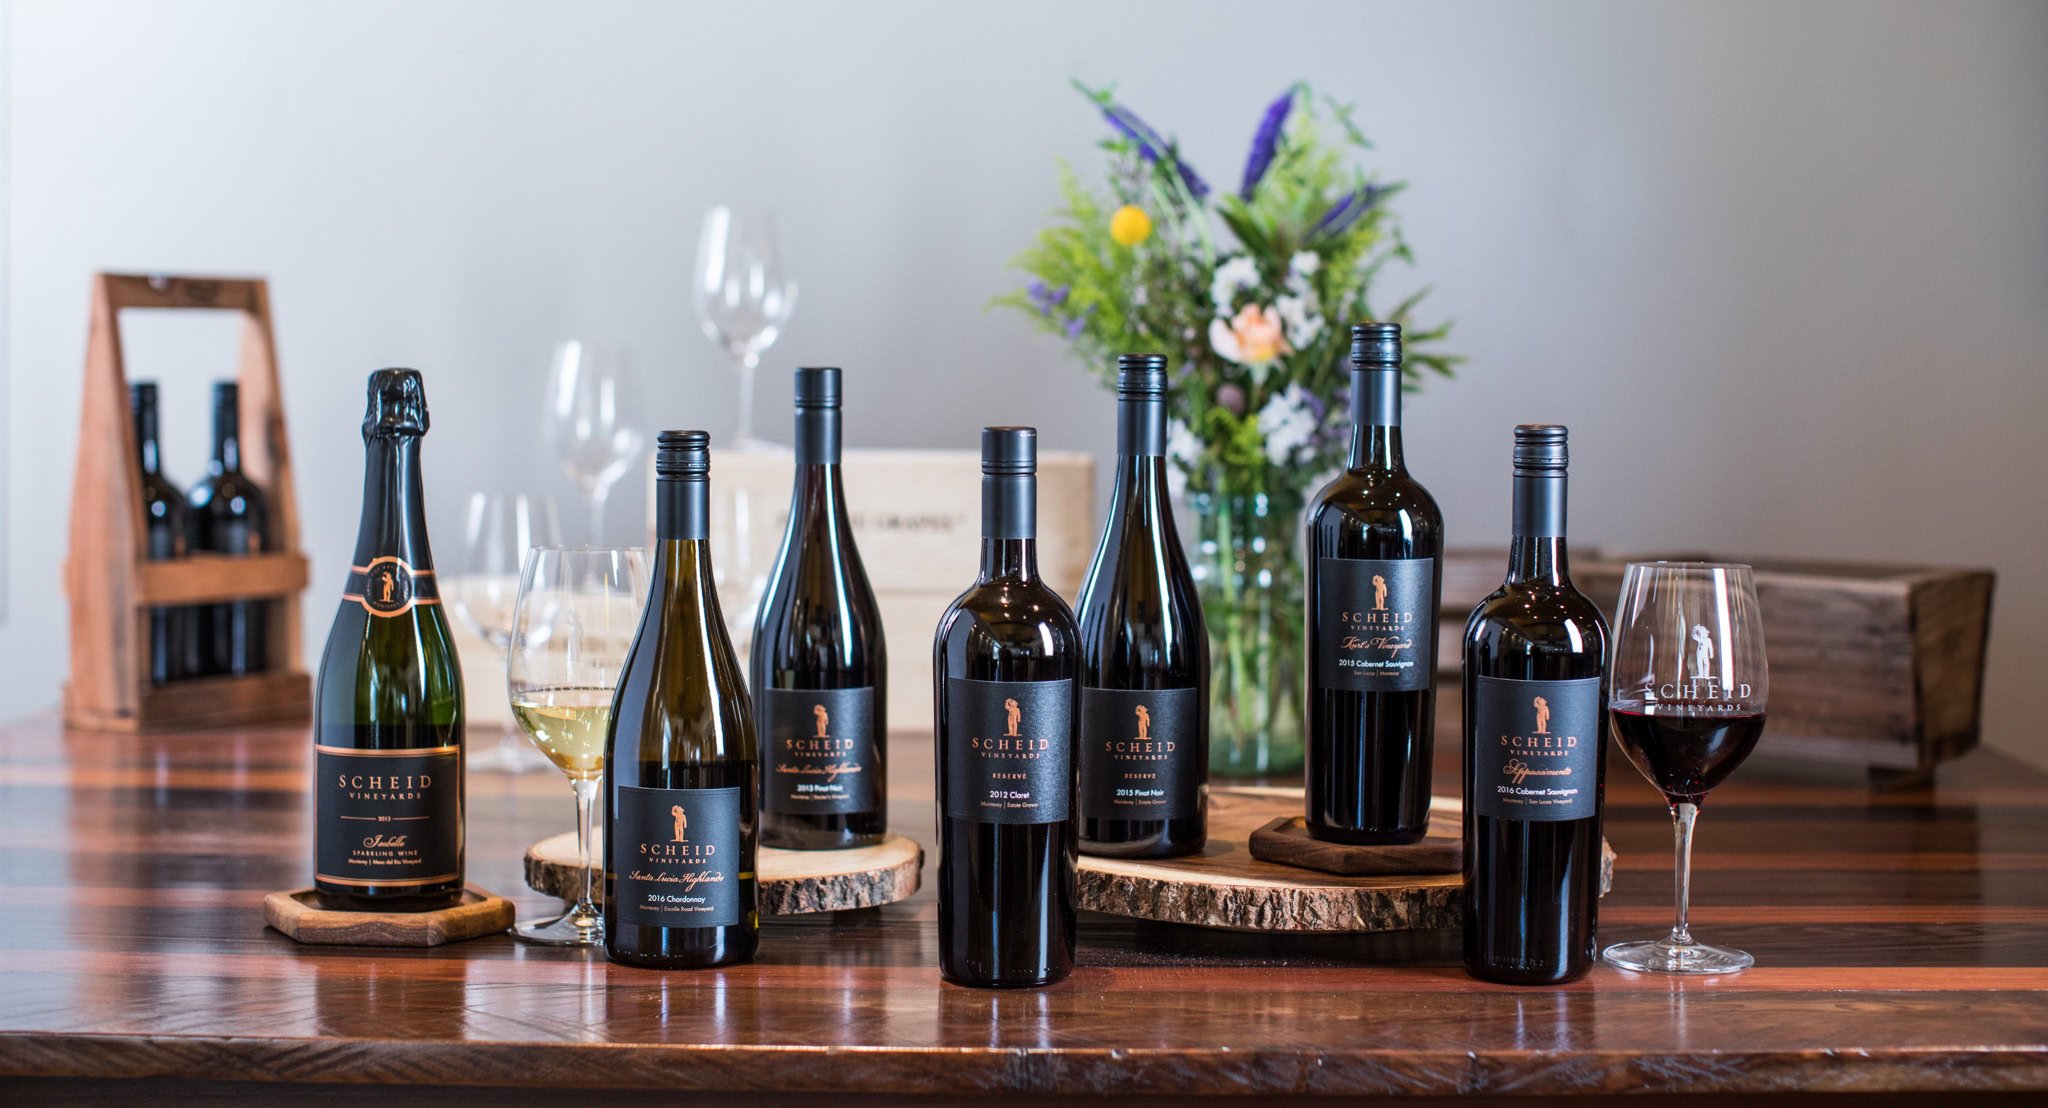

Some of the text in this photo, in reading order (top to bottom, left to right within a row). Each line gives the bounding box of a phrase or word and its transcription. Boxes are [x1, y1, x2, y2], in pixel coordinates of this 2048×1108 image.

[1342, 611, 1412, 623] SCHEID
[1370, 636, 1412, 658] Vineyard
[1339, 659, 1414, 669] 2015 Cabernet Sauvignon
[1644, 683, 1751, 700] SCHEID
[1656, 704, 1741, 712] VINEYARDS
[785, 739, 854, 750] SCHEID
[972, 737, 1049, 750] SCHEID
[1105, 741, 1176, 752] SCHEID
[1500, 735, 1577, 748] SCHEID
[339, 774, 432, 789] SCHEID
[797, 784, 844, 792] 2013 Pinot Noir
[1497, 786, 1578, 796] 2016 Cabernet Sauvignon
[349, 792, 421, 800] VINEYARDS
[990, 790, 1030, 799] 2012 Claret
[640, 843, 715, 856] SCHEID
[629, 870, 725, 892] Santa Lucia Highlands
[648, 894, 706, 904] 2016 Chardonnay
